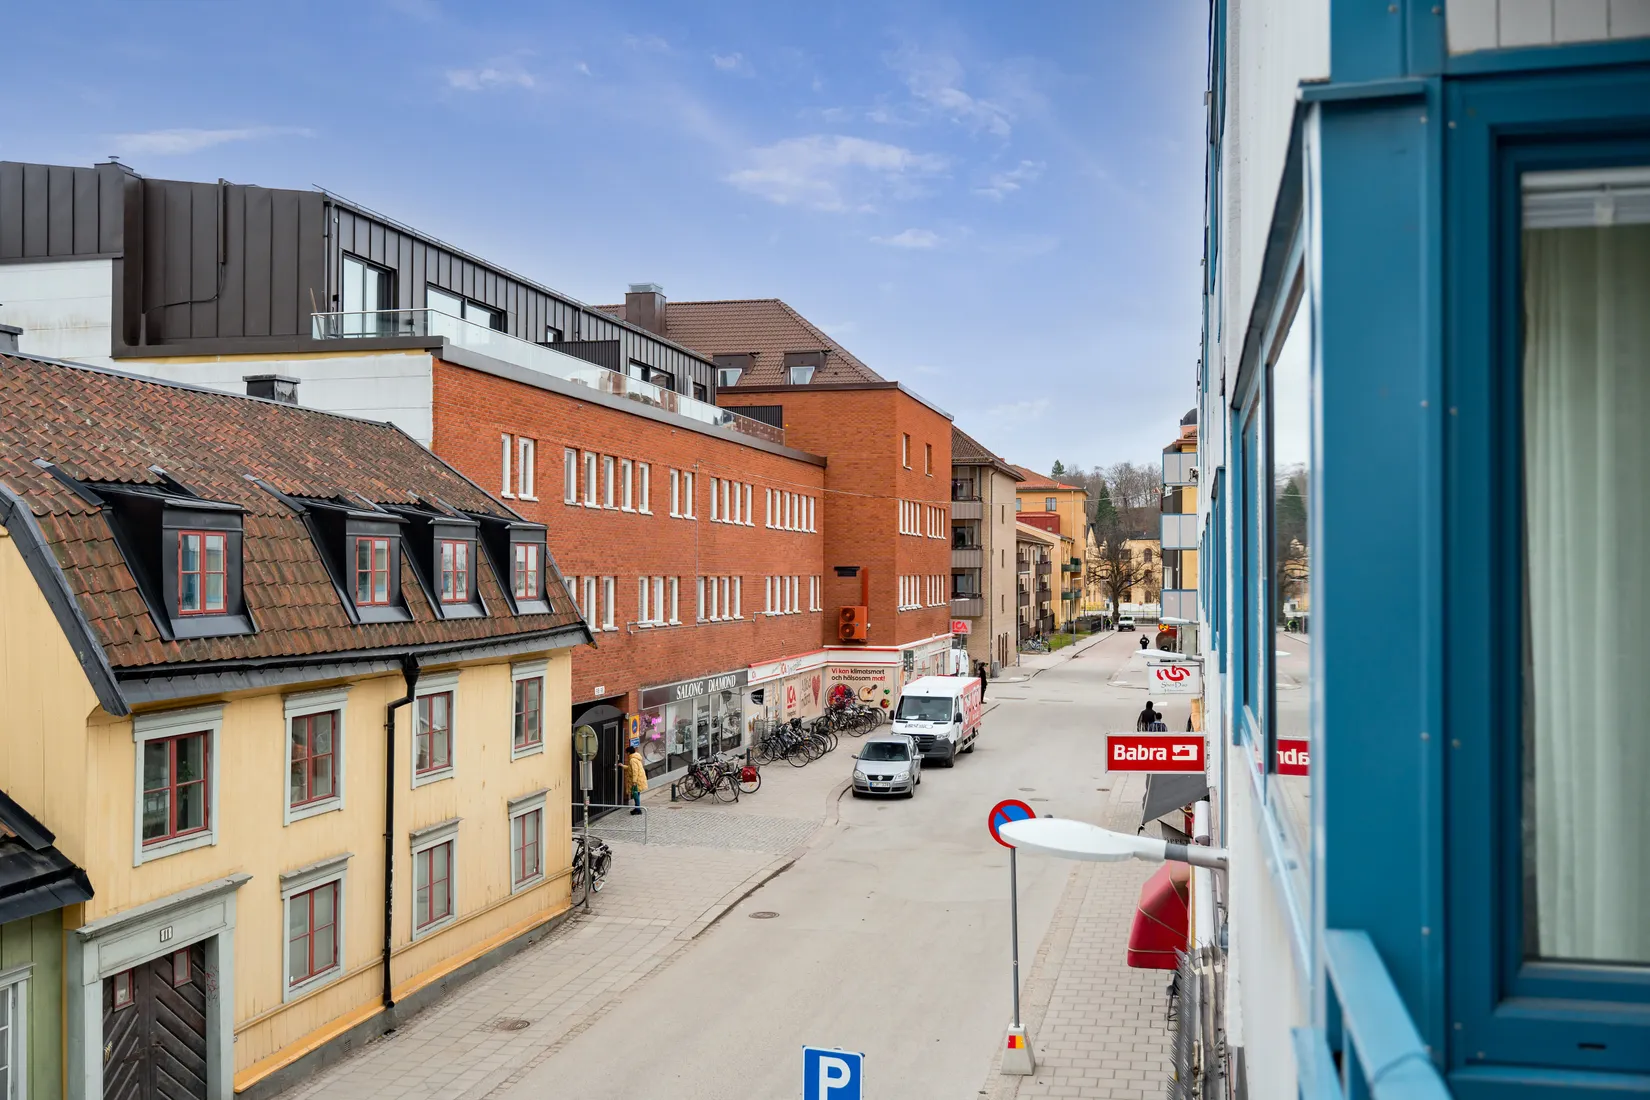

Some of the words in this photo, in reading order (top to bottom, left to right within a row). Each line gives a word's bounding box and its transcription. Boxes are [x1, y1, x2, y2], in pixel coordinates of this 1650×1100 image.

[952, 621, 968, 631] ICA
[676, 681, 704, 700] SALONG
[708, 674, 736, 693] DIAMOND
[786, 685, 797, 704] ICA
[1114, 744, 1167, 761] Babra
[819, 1056, 851, 1100] P
